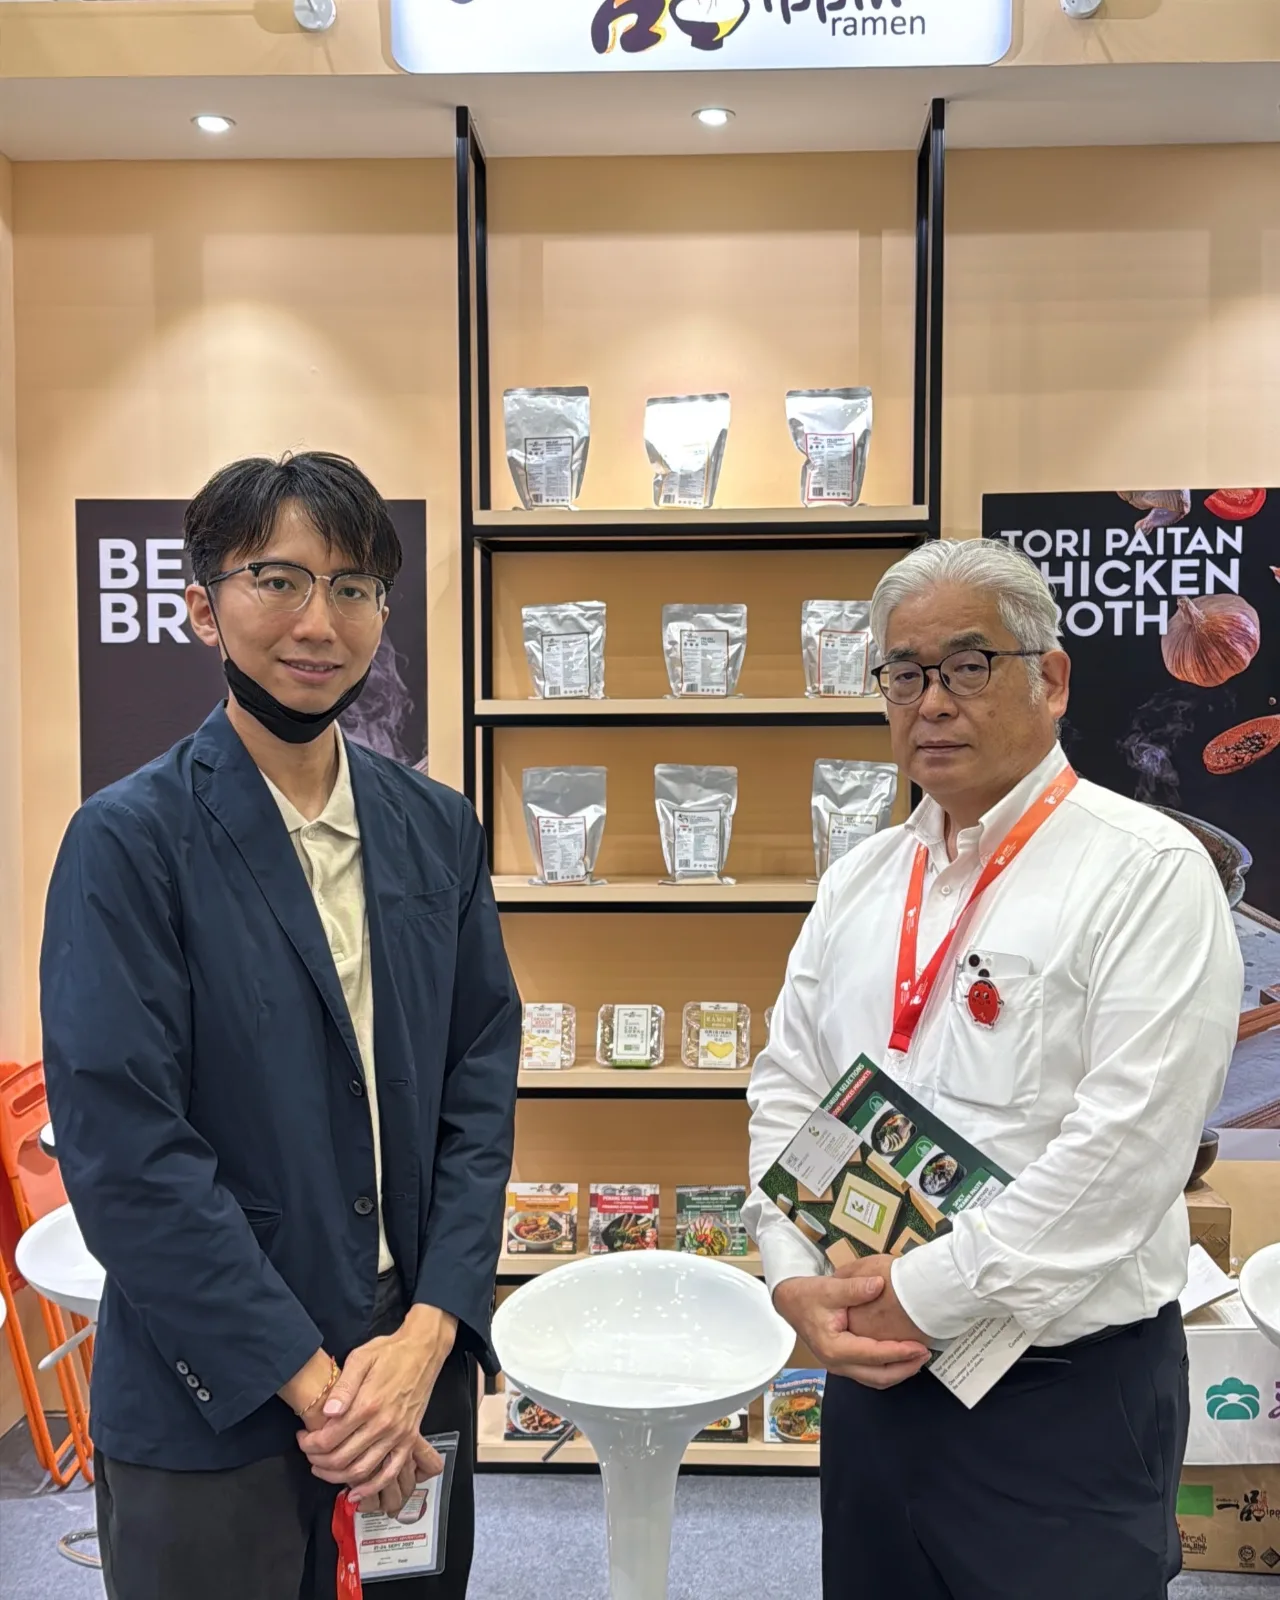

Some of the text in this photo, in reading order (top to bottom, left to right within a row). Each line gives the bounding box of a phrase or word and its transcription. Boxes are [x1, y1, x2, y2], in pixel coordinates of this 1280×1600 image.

[831, 15, 926, 37] ramen
[1001, 526, 1243, 558] TORI PAITAN
[99, 538, 185, 589] BE
[1040, 558, 1239, 597] HICKEN
[100, 593, 191, 643] BR
[838, 1062, 864, 1093] SELECTIONS
[852, 1068, 871, 1090] PRODUCTS
[951, 1193, 965, 1208] SPICY
[969, 1179, 983, 1195] PASTE
